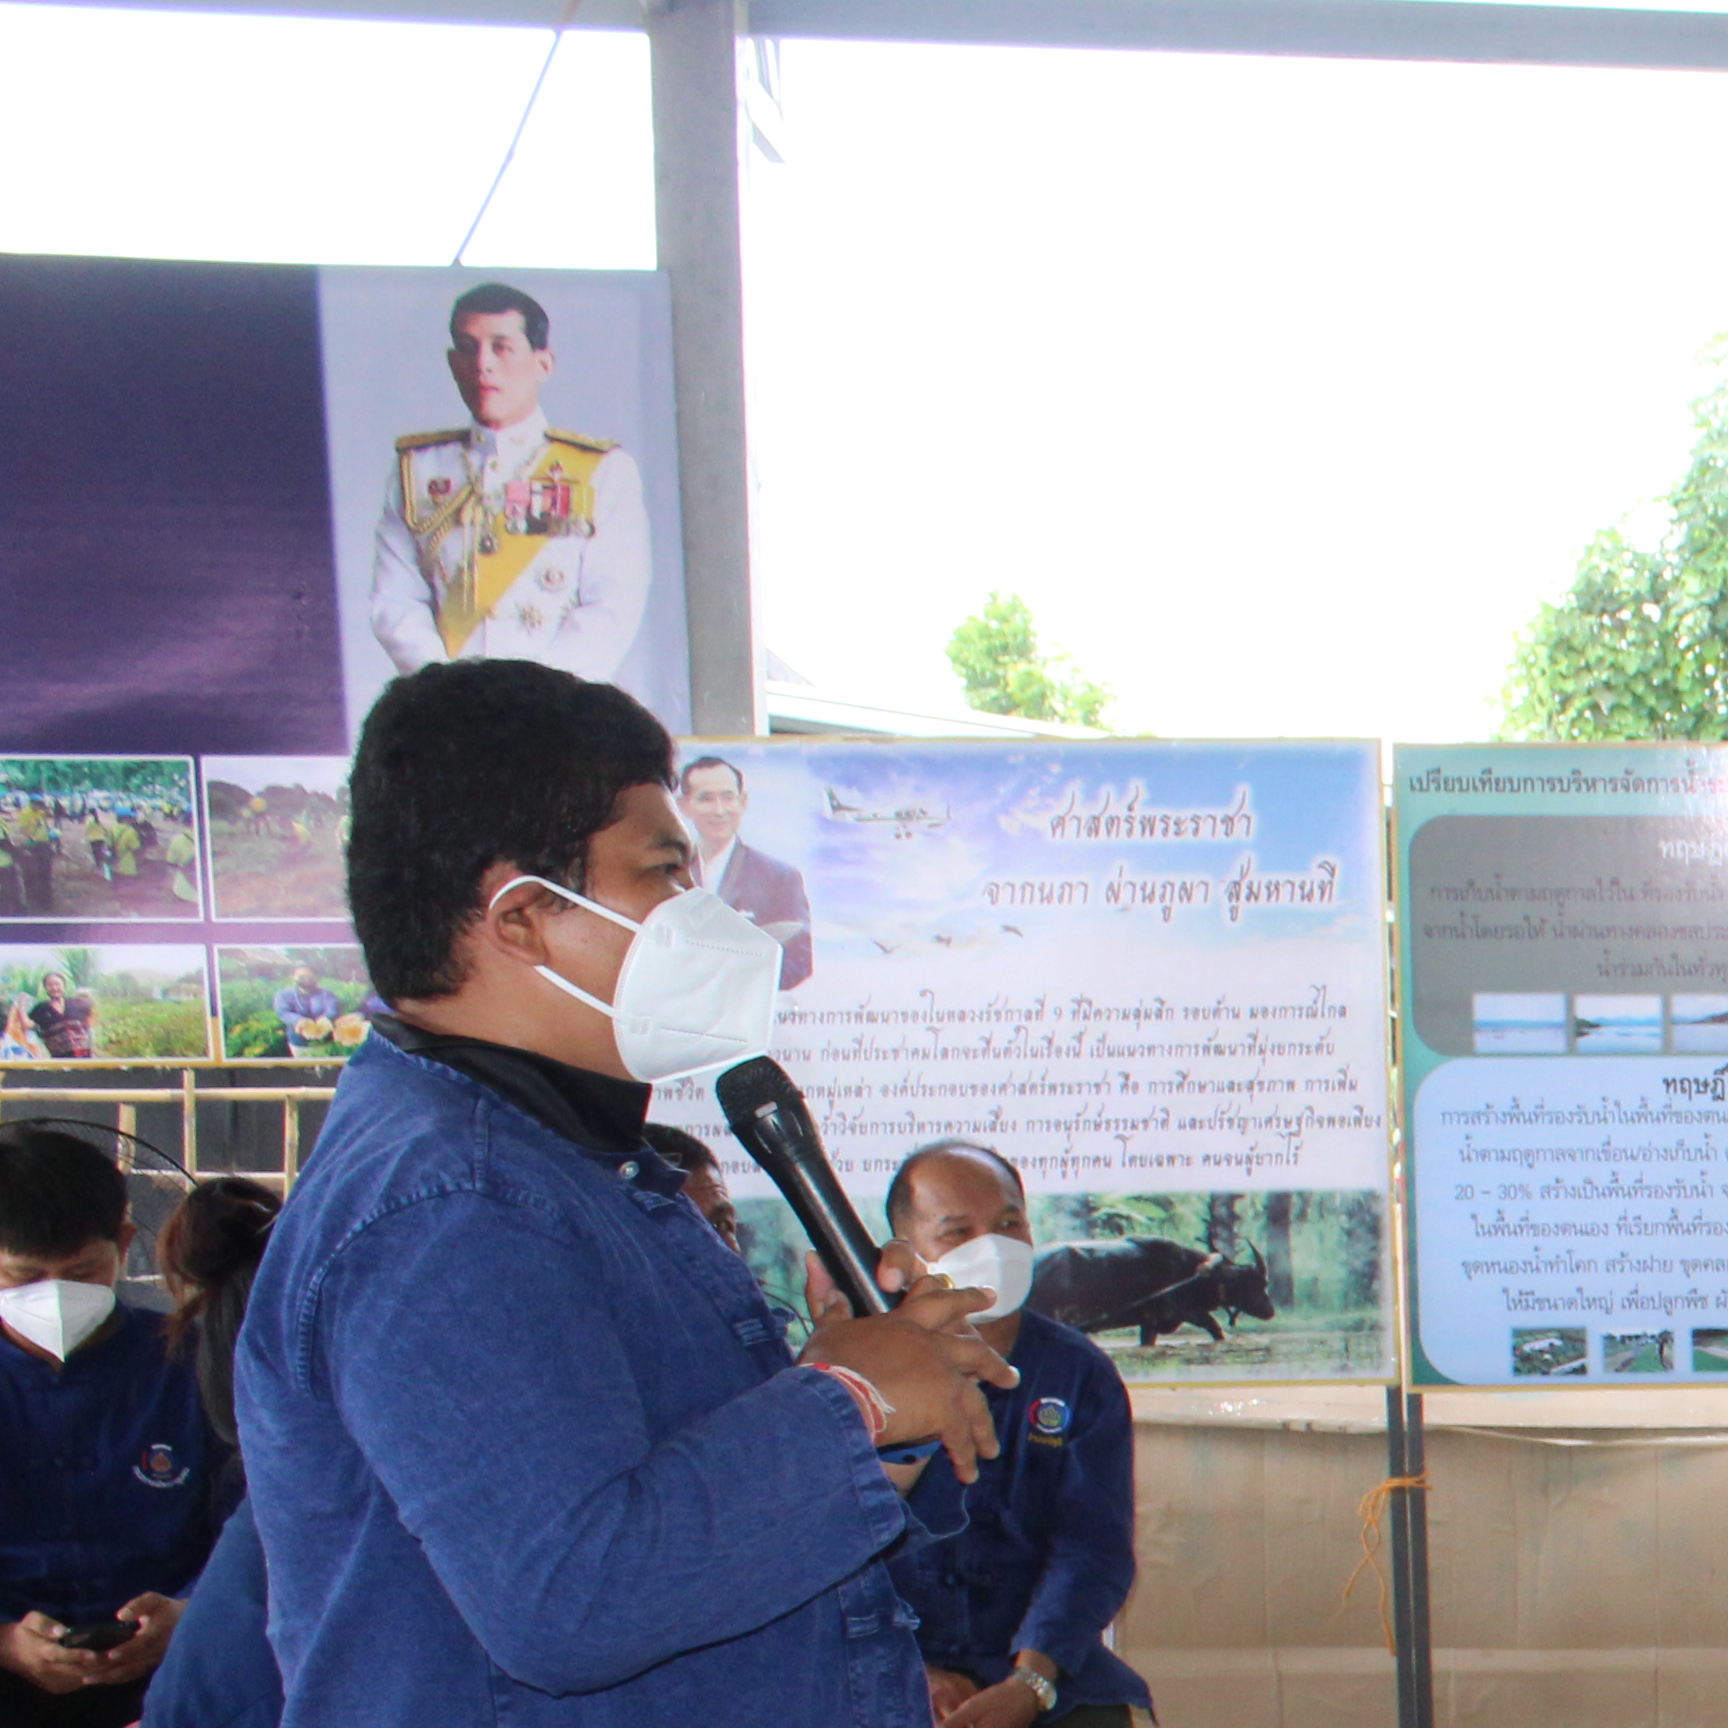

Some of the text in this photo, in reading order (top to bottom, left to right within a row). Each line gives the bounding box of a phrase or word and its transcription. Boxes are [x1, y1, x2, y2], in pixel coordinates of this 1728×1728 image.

[1049, 785, 1253, 839] ศาสตร์พระราชา
[983, 879, 1090, 906] จากนภา
[1105, 866, 1210, 923] ผ่านภูผา
[1454, 1184, 1475, 1201] 20
[1497, 1184, 1533, 1201] 30%
